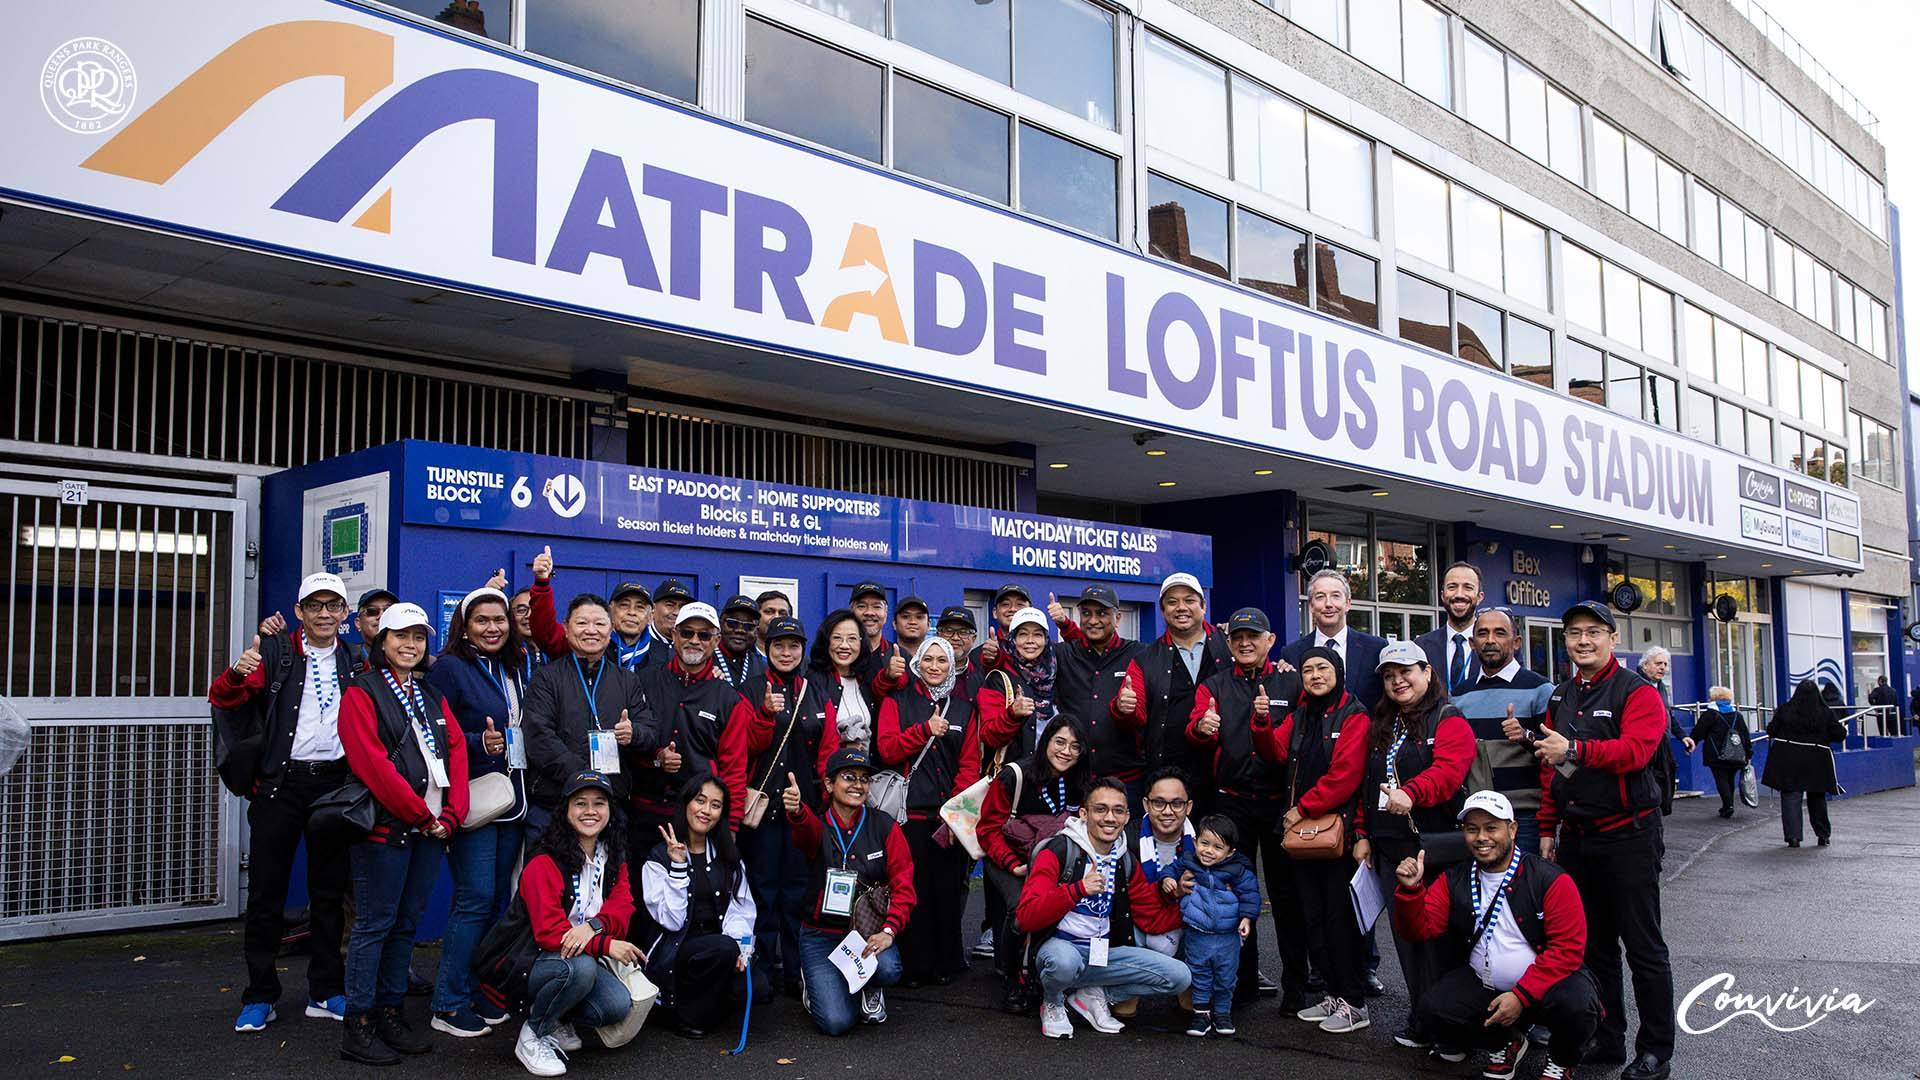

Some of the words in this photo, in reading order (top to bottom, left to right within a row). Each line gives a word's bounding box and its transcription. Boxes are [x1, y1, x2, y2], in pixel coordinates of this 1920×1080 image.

[79, 20, 1046, 376] MATRADE
[1106, 271, 1378, 450] LOFTUS
[1401, 363, 1548, 485] ROAD
[1563, 414, 1715, 527] STADIUM
[66, 490, 81, 502] 21
[427, 466, 504, 489] TURNSTILE
[510, 476, 532, 509] 6
[427, 484, 482, 504] BLOCK
[628, 474, 664, 493] EAST
[667, 478, 742, 502] PADDOCK
[758, 489, 799, 508] HOME
[802, 494, 880, 517] SUPPORTERS
[700, 503, 748, 523] Blocks
[751, 509, 769, 529] EL,
[773, 511, 787, 527] FL
[790, 513, 800, 529] &
[803, 514, 822, 530] GL
[617, 516, 660, 532] Season
[662, 519, 694, 535] ticket
[696, 525, 736, 540] holders
[738, 527, 747, 540] &
[749, 529, 801, 547] matchday
[803, 533, 831, 547] ticket
[832, 536, 868, 550] holders
[869, 540, 889, 554] only
[991, 516, 1073, 544] MATCHDAY
[1074, 525, 1119, 549] TICKET
[1121, 531, 1157, 553] SALES
[1012, 545, 1057, 569] HOME
[1059, 552, 1142, 577] SUPPORTERS
[1512, 550, 1541, 576] Box
[1507, 580, 1550, 608] Office
